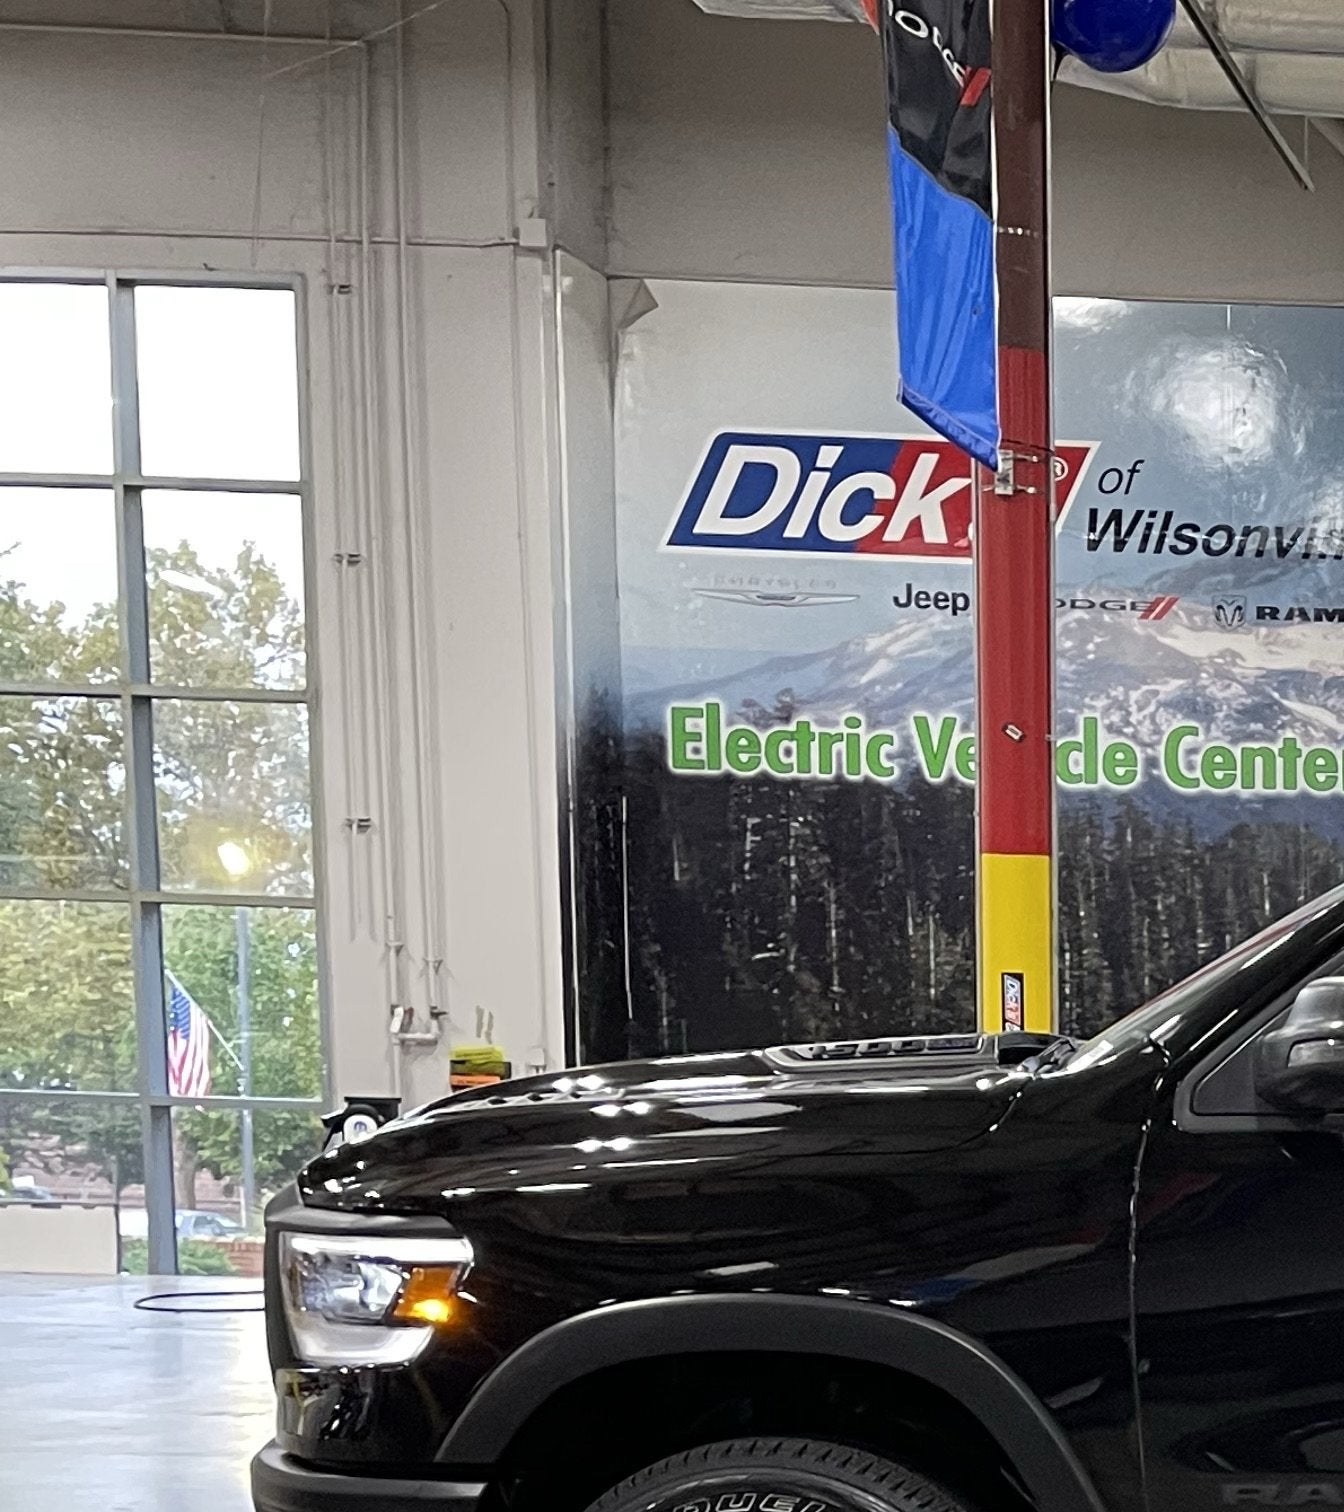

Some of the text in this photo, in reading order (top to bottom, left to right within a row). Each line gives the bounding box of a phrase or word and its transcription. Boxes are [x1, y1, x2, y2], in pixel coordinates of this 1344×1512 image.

[692, 445, 1145, 545] Dick of
[893, 583, 970, 616] Jeep
[1056, 598, 1154, 611] DGE
[671, 702, 895, 777] Electric
[913, 716, 1138, 785] Vecle
